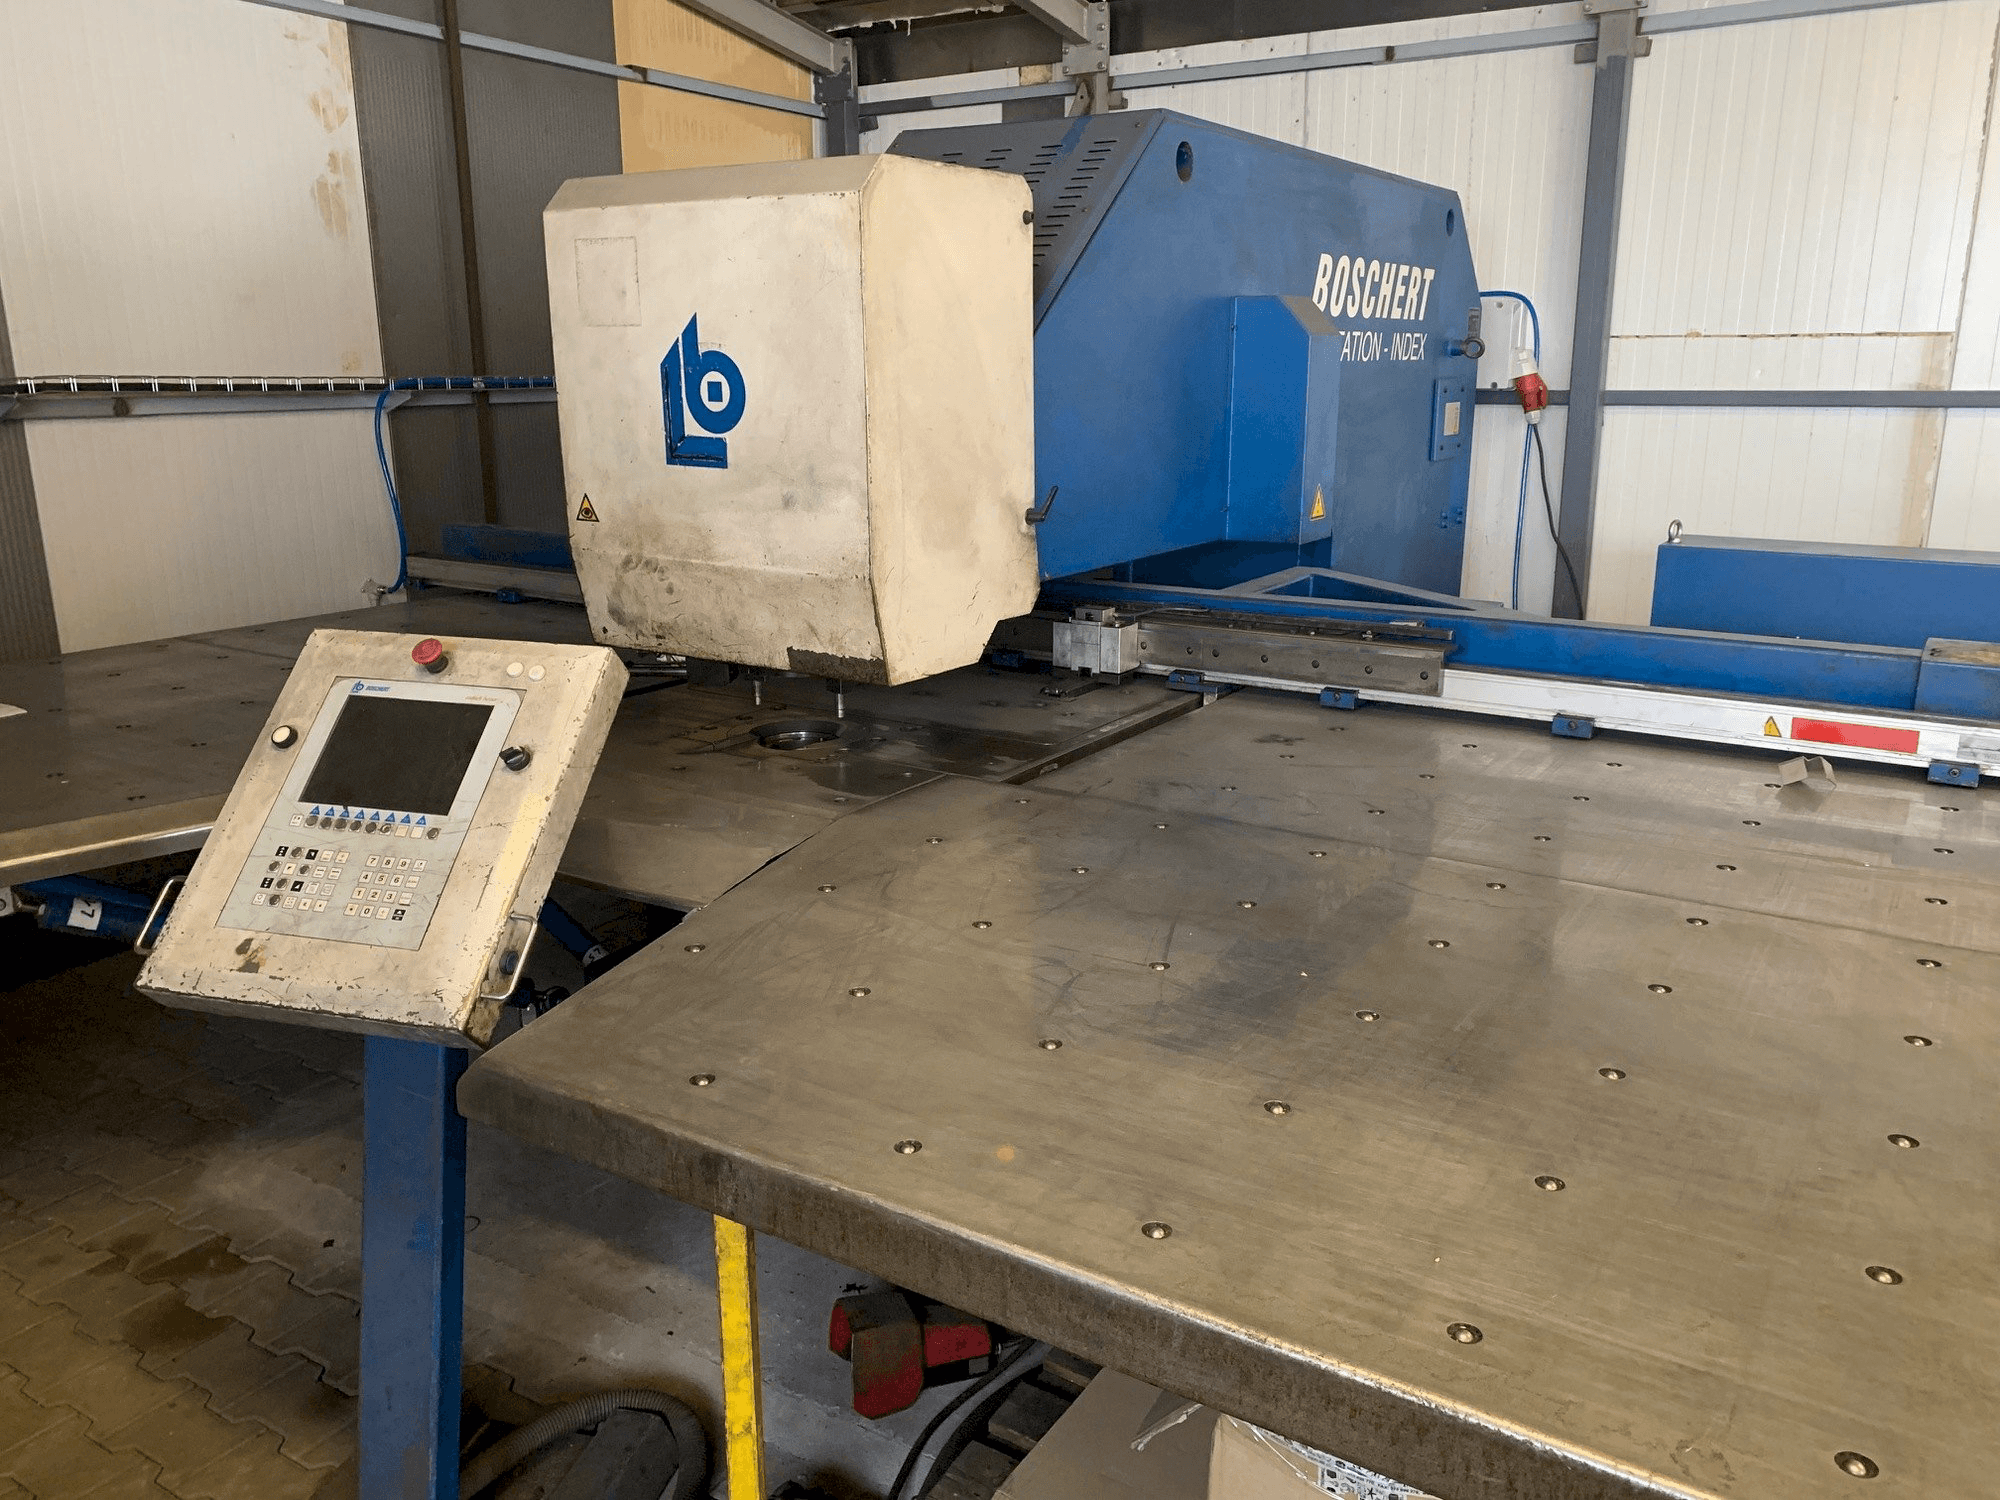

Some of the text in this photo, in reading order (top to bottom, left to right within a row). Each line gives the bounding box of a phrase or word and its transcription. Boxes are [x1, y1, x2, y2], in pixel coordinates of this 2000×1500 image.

[1312, 253, 1436, 321] BOSCHERT
[1339, 330, 1383, 362] ATION
[1390, 332, 1428, 361] INDEX
